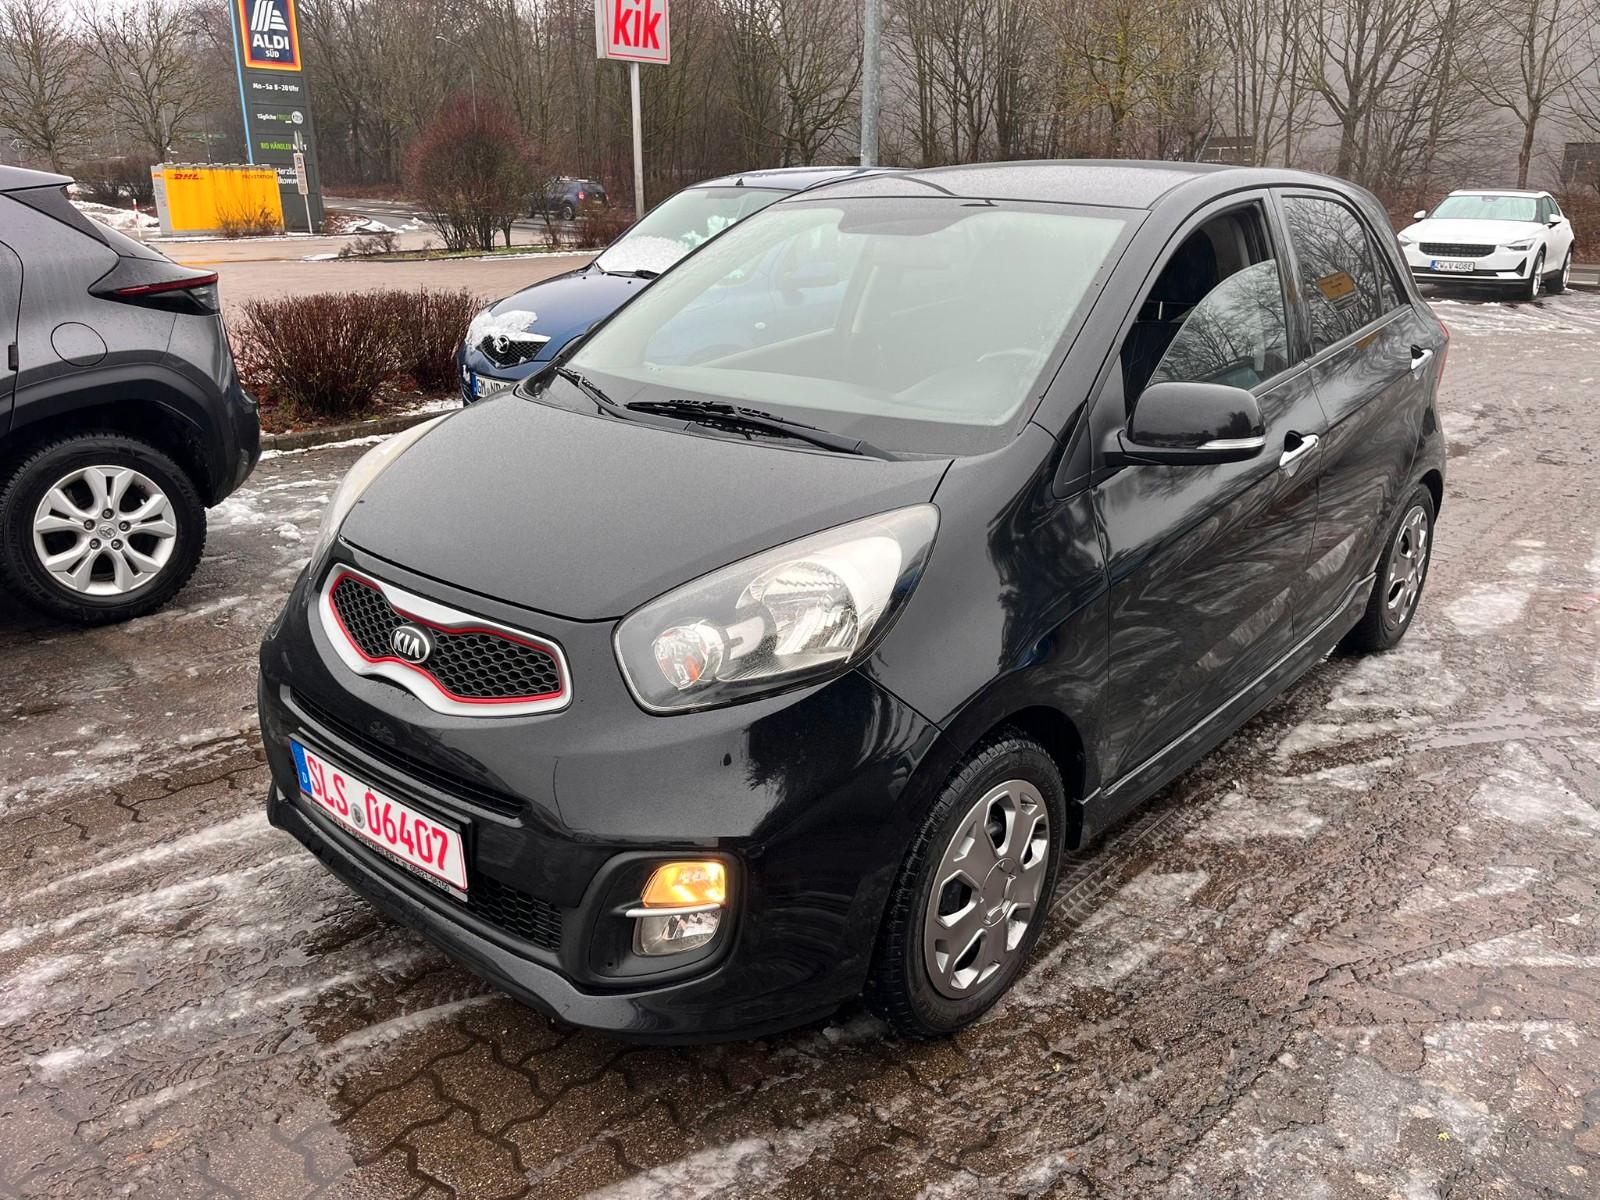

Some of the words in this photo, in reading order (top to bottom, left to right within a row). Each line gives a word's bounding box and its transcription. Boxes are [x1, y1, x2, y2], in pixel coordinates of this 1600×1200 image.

[613, 0, 661, 49] kik
[252, 33, 290, 50] ALDI
[265, 49, 280, 58] SÜD
[476, 378, 487, 395] GM
[393, 630, 420, 659] KIA
[307, 755, 348, 816] SLS
[364, 791, 448, 871] 06407
